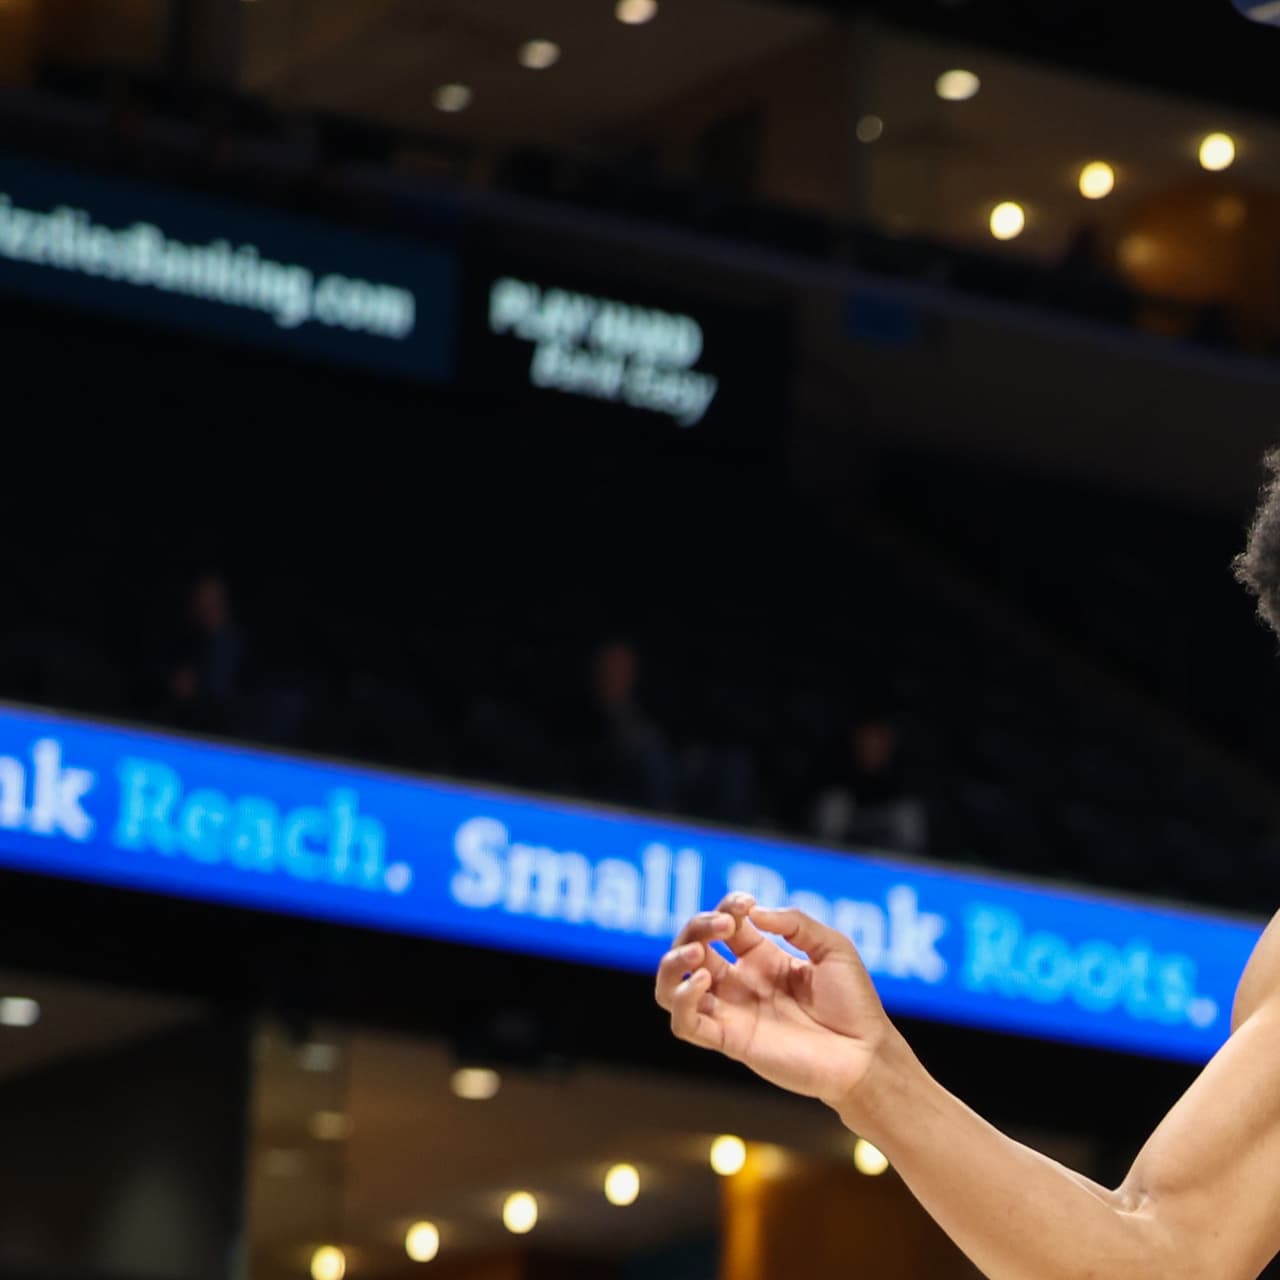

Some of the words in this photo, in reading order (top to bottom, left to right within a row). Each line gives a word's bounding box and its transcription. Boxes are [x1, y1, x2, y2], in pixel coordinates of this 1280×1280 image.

[114, 756, 413, 893] Reach.
[451, 816, 703, 937] Small
[961, 900, 1217, 1027] Roots.
